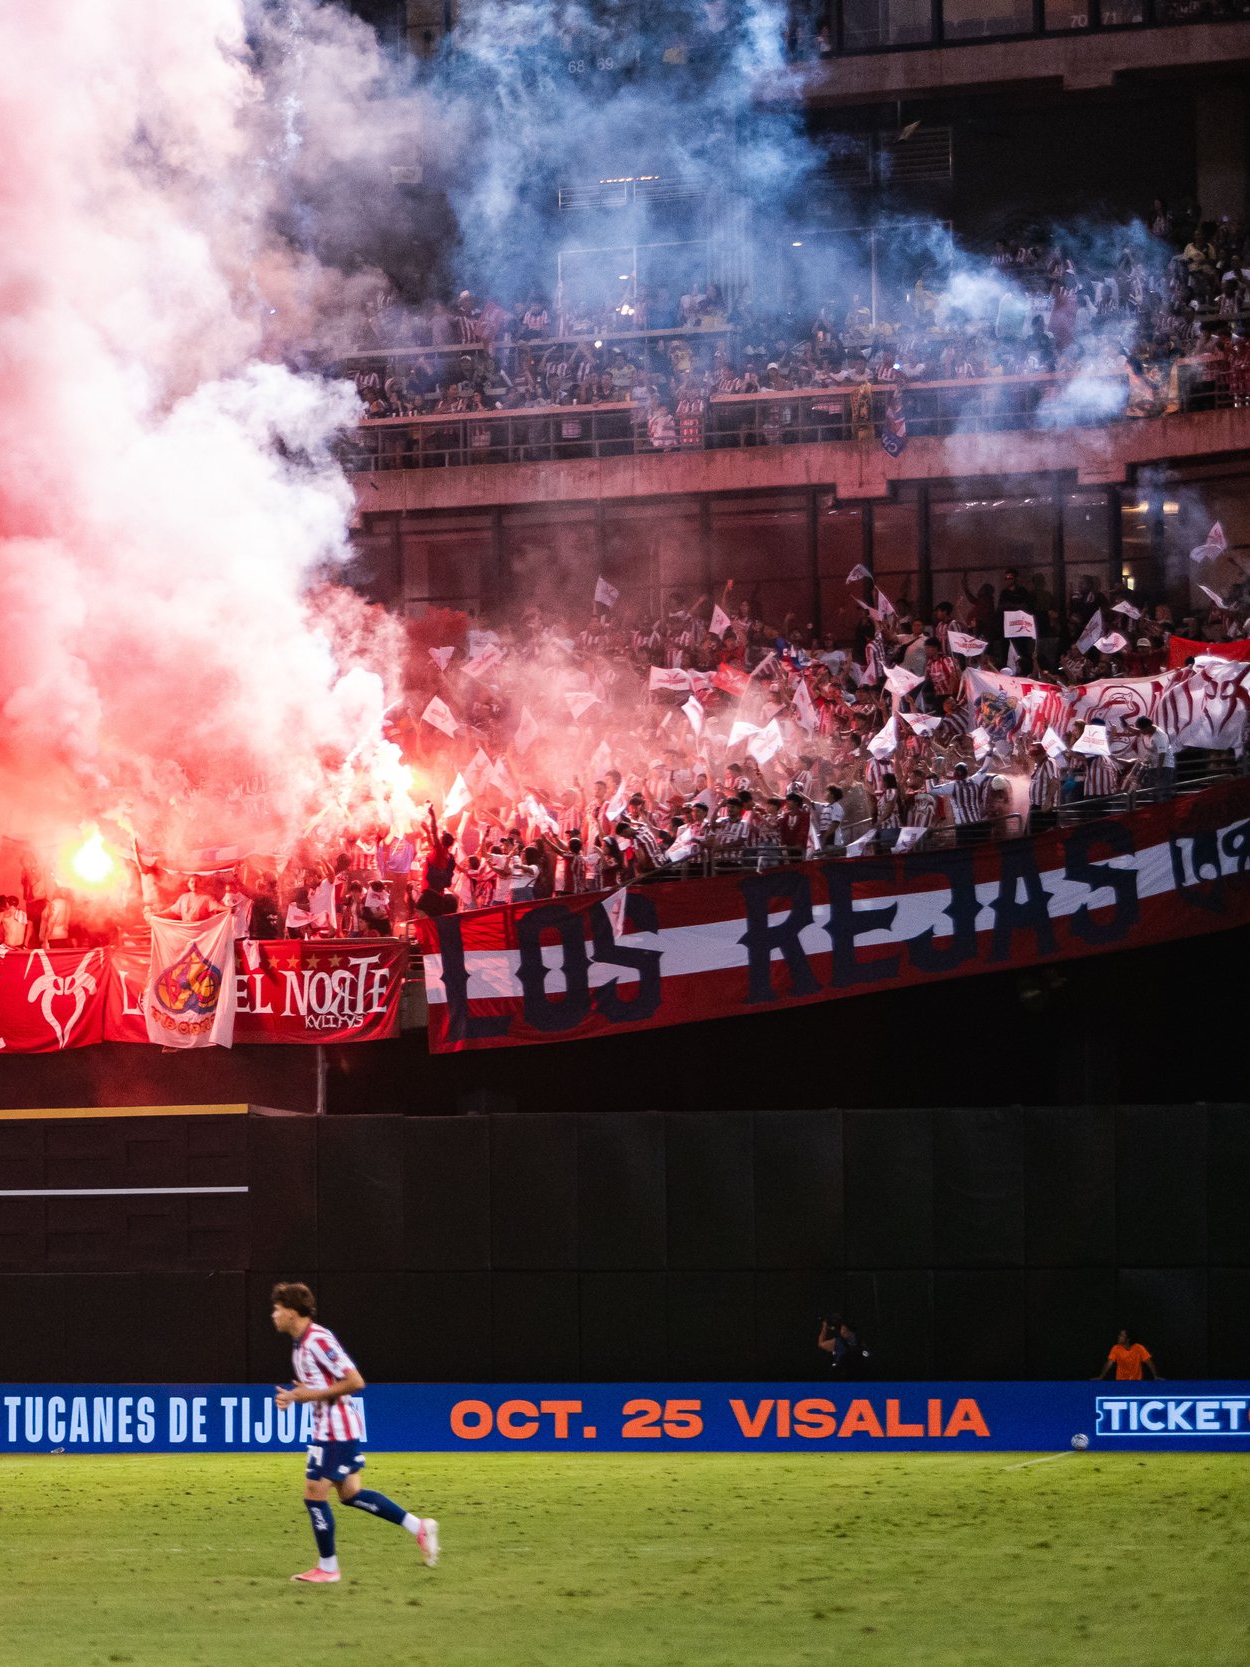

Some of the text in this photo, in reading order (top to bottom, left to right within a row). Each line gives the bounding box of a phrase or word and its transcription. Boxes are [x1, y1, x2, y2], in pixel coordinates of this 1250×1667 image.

[1070, 14, 1088, 28] 70
[1102, 11, 1118, 25] 71
[568, 60, 585, 73] 68
[597, 57, 614, 71] 69
[434, 823, 1141, 1041] LOS REJAS
[279, 953, 390, 1017] NORTE
[4, 1396, 155, 1443] TUCANES
[169, 1397, 207, 1443] DE
[220, 1397, 367, 1443] TIJUA
[450, 1398, 991, 1439] OCT. 25 VISALIA
[1103, 1401, 1250, 1431] TICKET
